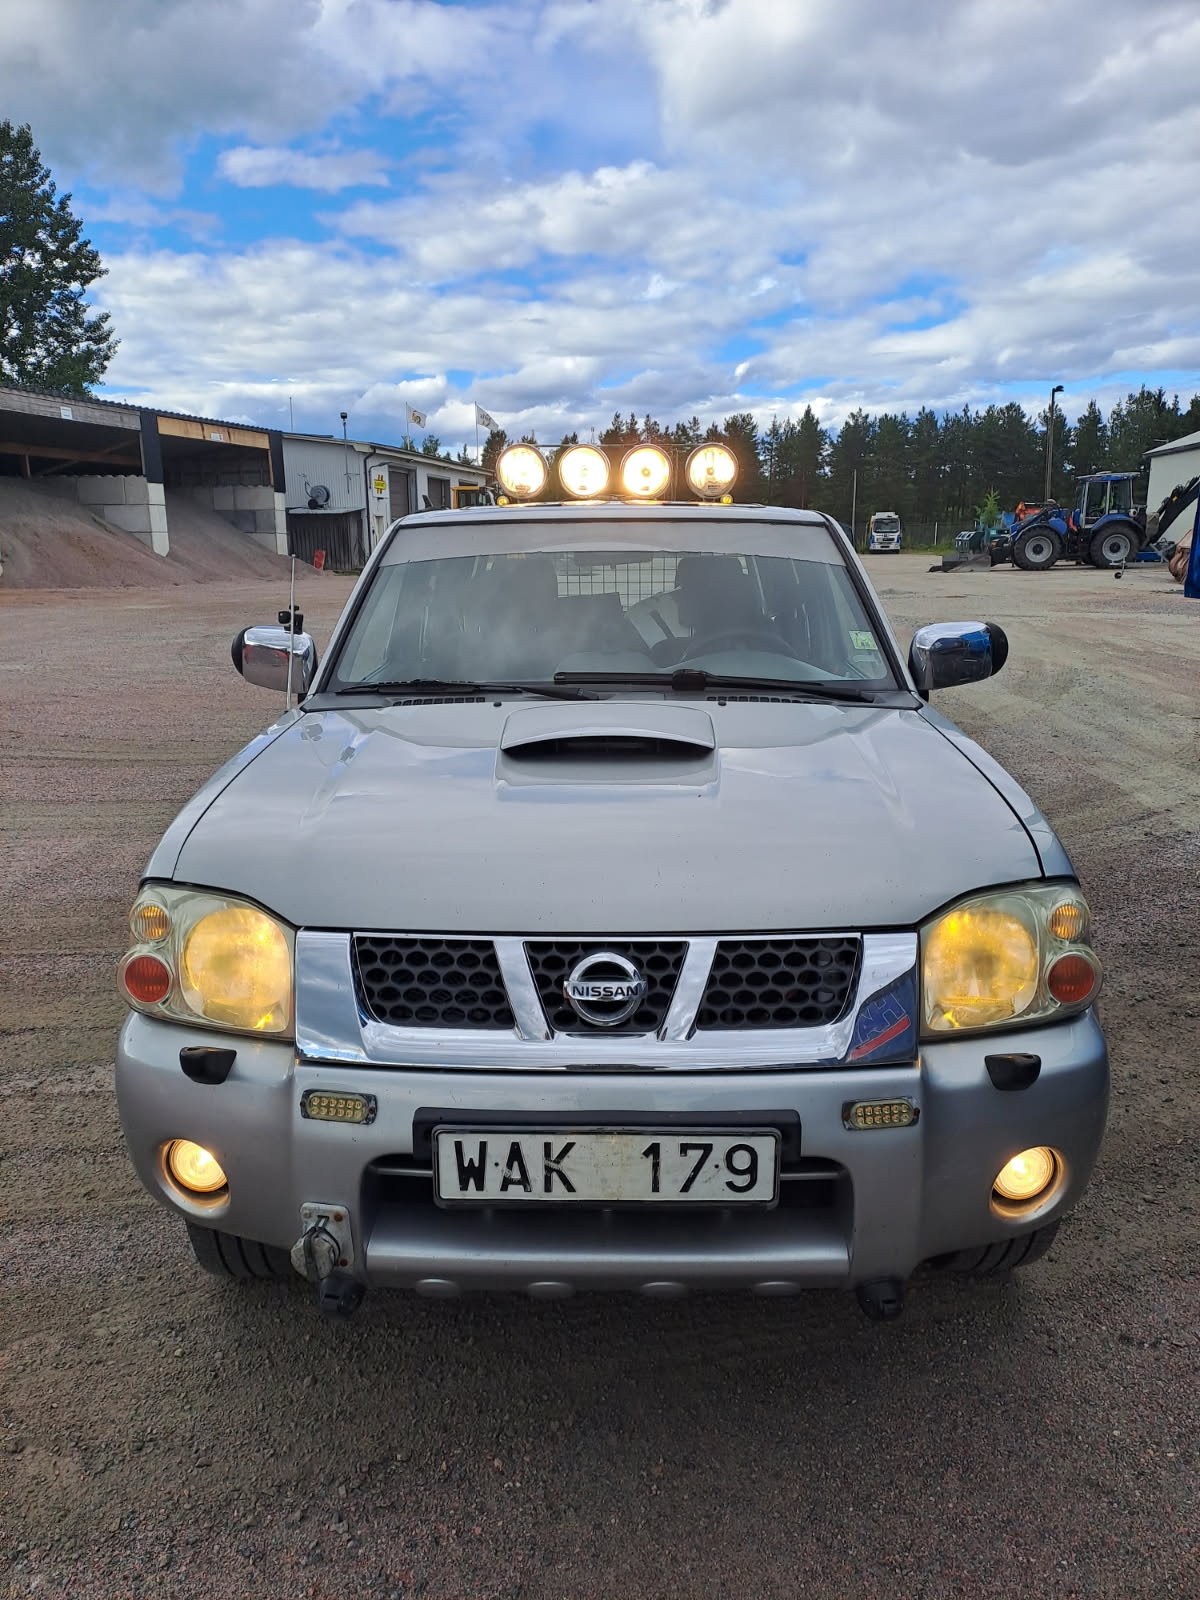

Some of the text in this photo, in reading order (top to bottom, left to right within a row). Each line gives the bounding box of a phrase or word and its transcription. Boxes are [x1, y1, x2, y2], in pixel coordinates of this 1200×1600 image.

[572, 985, 639, 997] NISSAN
[454, 1140, 759, 1193] WAK 179
